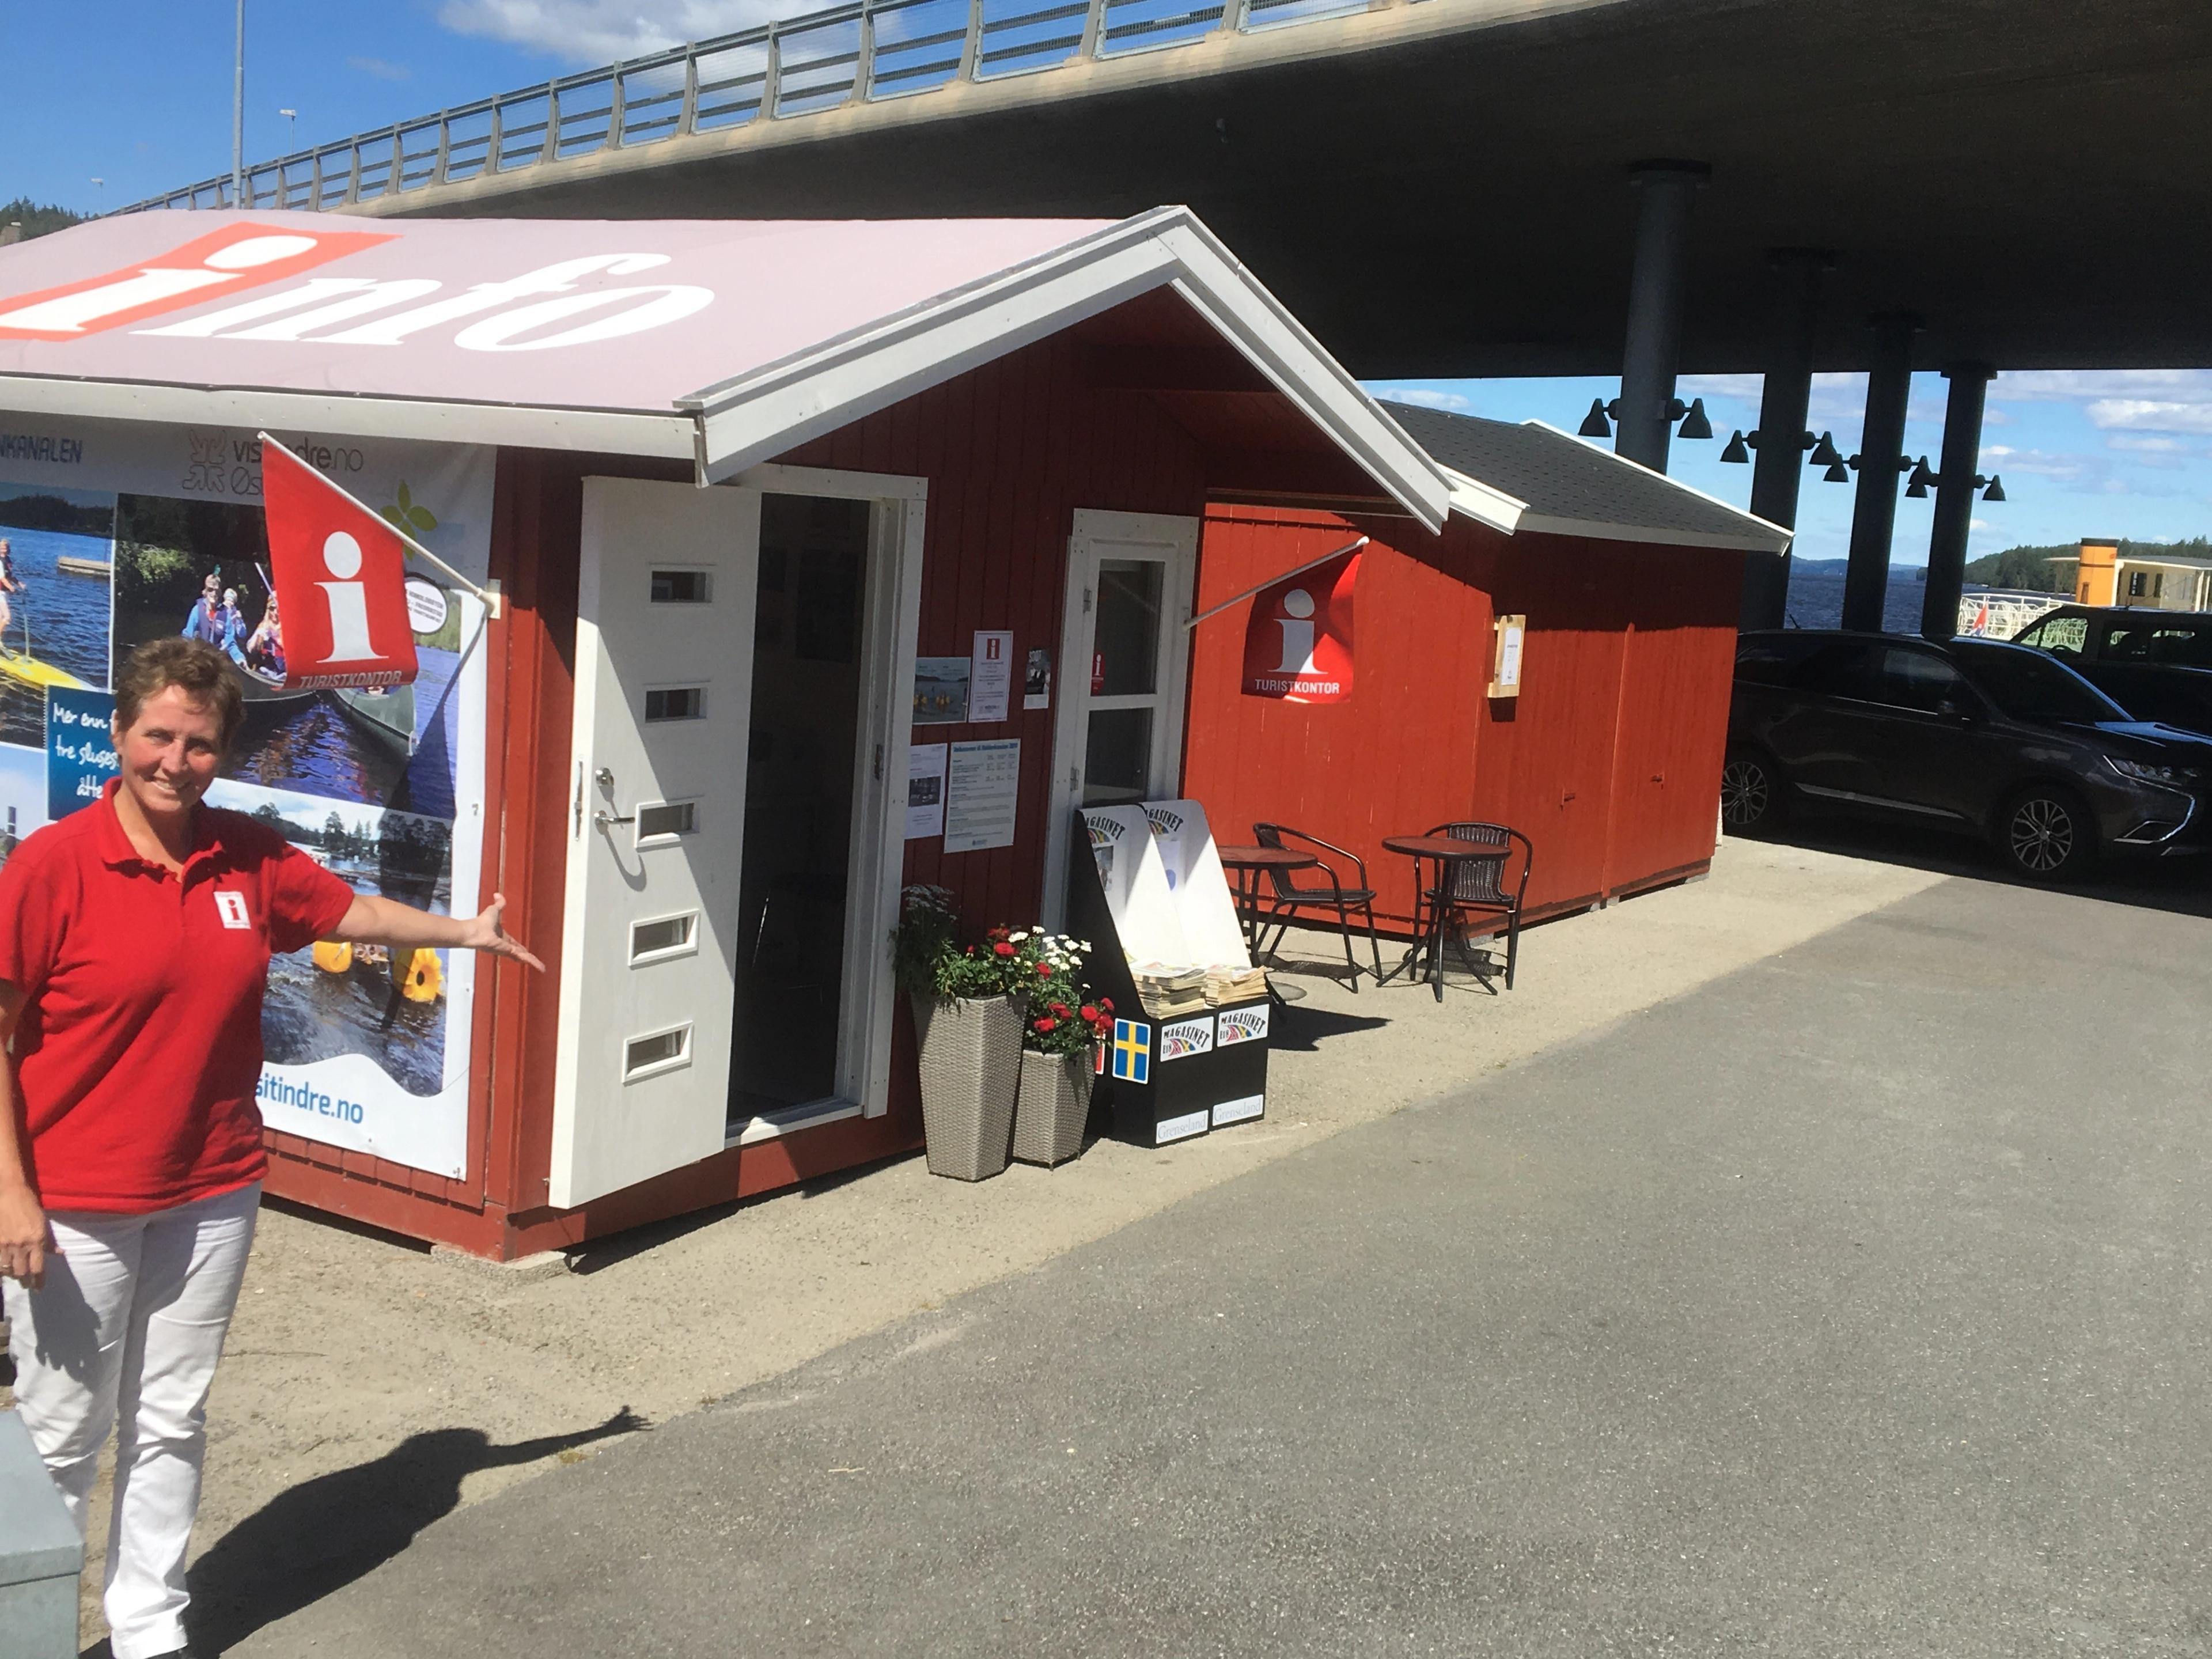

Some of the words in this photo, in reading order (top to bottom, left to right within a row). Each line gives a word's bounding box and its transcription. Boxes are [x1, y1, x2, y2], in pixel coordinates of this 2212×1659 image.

[0, 235, 715, 351] info
[300, 671, 402, 688] TURISTKONTOR
[1255, 679, 1340, 694] TURISTKONTOR
[53, 702, 77, 724] Mer
[55, 734, 76, 759] tre
[1086, 816, 1126, 840] GASINET
[1145, 808, 1184, 832] GASINET
[1221, 1013, 1266, 1034] MAGASINET
[1164, 1026, 1210, 1048] MAGASINET
[255, 1073, 363, 1124] sitindre.no
[1214, 1097, 1262, 1123] Grenseland
[1157, 1113, 1206, 1139] Grenseland
